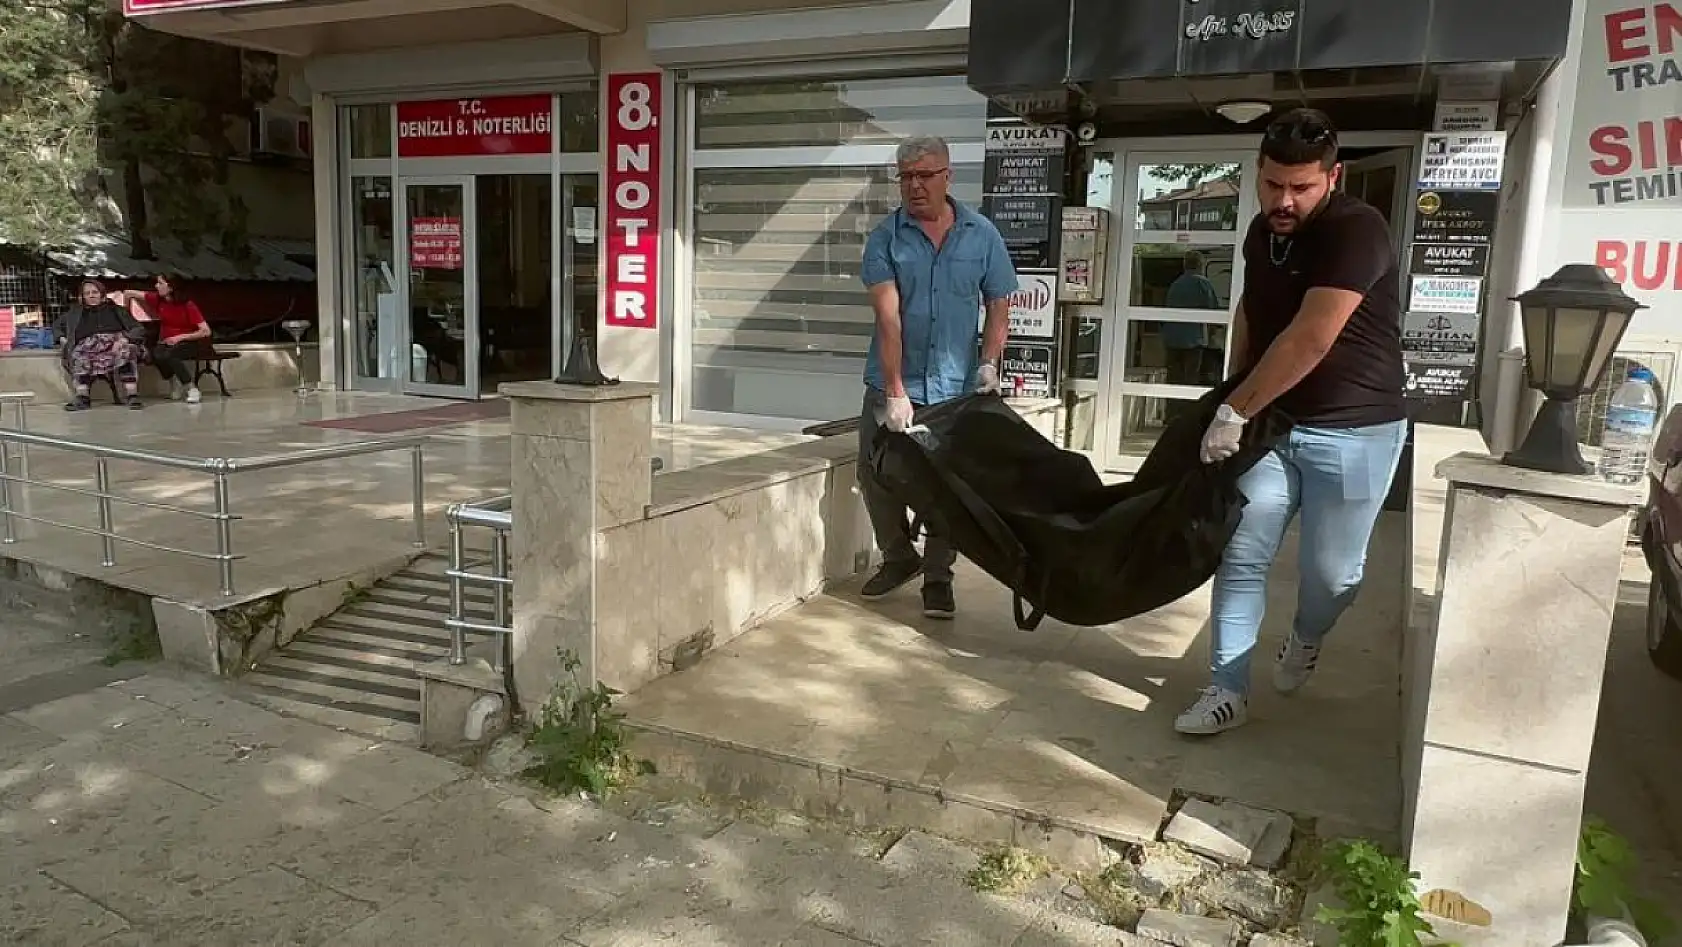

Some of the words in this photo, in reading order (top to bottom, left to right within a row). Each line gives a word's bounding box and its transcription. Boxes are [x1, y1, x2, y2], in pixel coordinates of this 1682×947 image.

[1607, 58, 1682, 91] TRA
[458, 100, 487, 115] T.C.
[617, 82, 658, 131] 8.
[399, 115, 453, 138] DENİZLİ
[456, 119, 469, 136] 8.
[473, 111, 551, 136] NOTERLİĞİ
[991, 128, 1059, 140] AVUKAT
[1002, 157, 1046, 167] AVUKAT
[1588, 166, 1682, 206] TEMİ
[614, 143, 650, 320] NOTER
[1424, 247, 1476, 258] AVUKAT
[1596, 240, 1682, 291] BU
